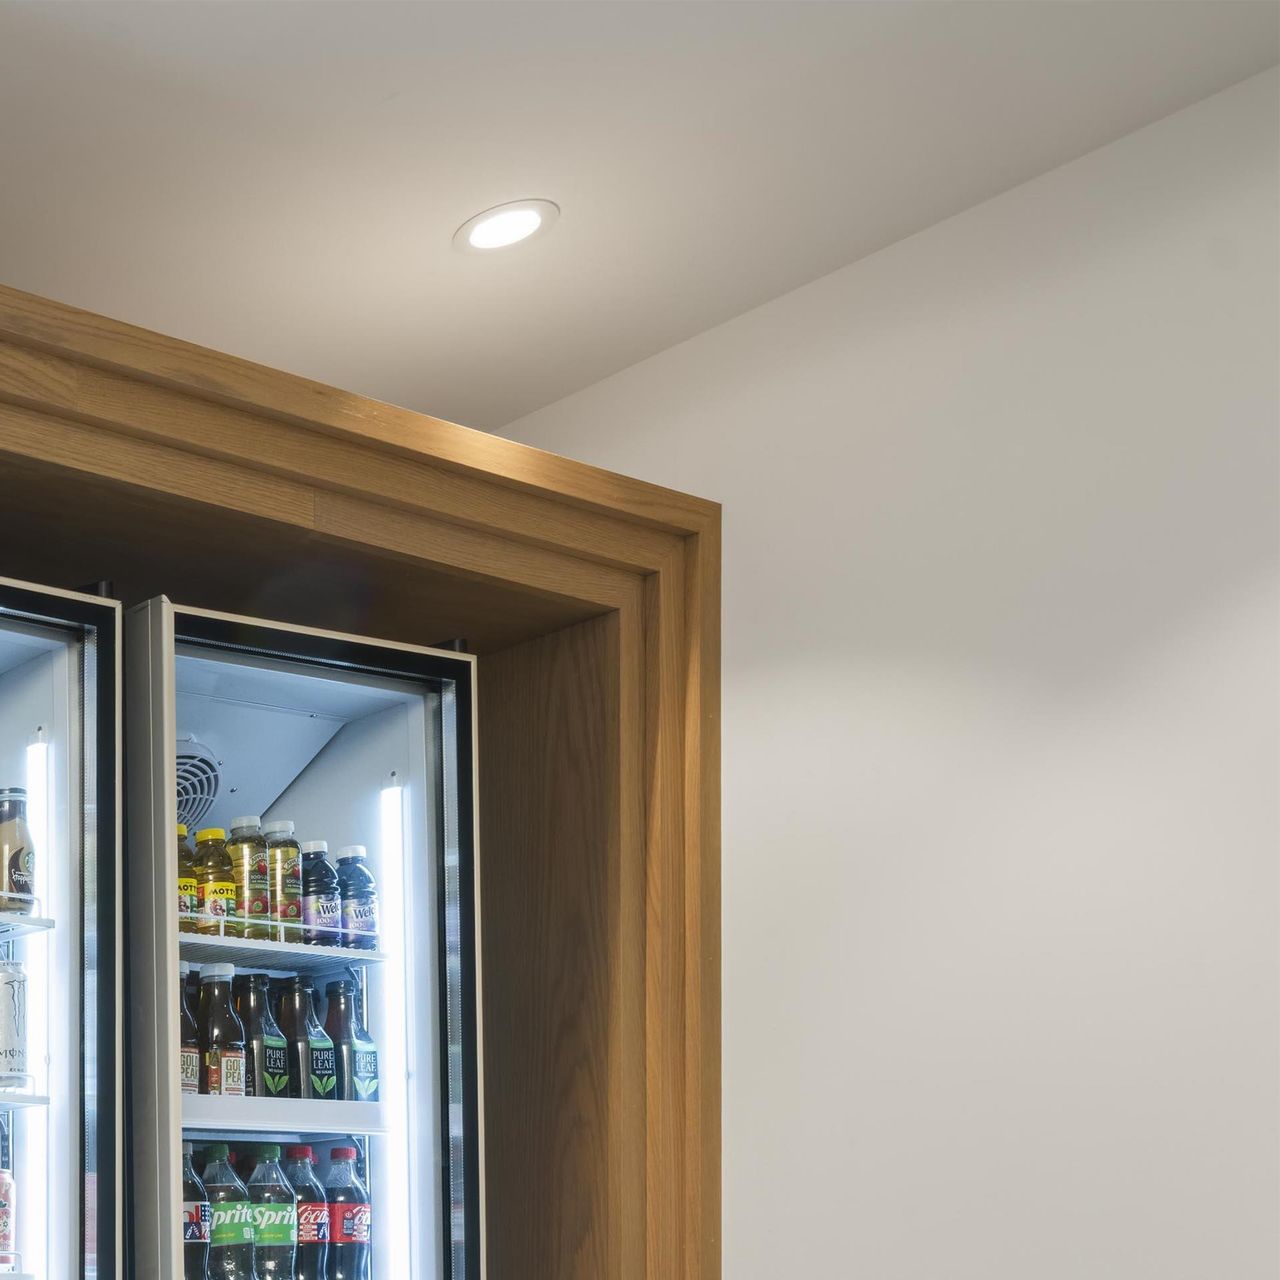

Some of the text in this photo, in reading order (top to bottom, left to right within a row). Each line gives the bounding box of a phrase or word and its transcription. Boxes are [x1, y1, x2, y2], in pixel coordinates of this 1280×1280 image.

[267, 1050, 285, 1059] PURE
[313, 1051, 333, 1060] PURE
[356, 1053, 376, 1063] PURE
[267, 1059, 285, 1068] LEAF
[313, 1060, 333, 1069] LEAF
[356, 1063, 376, 1072] LEAF
